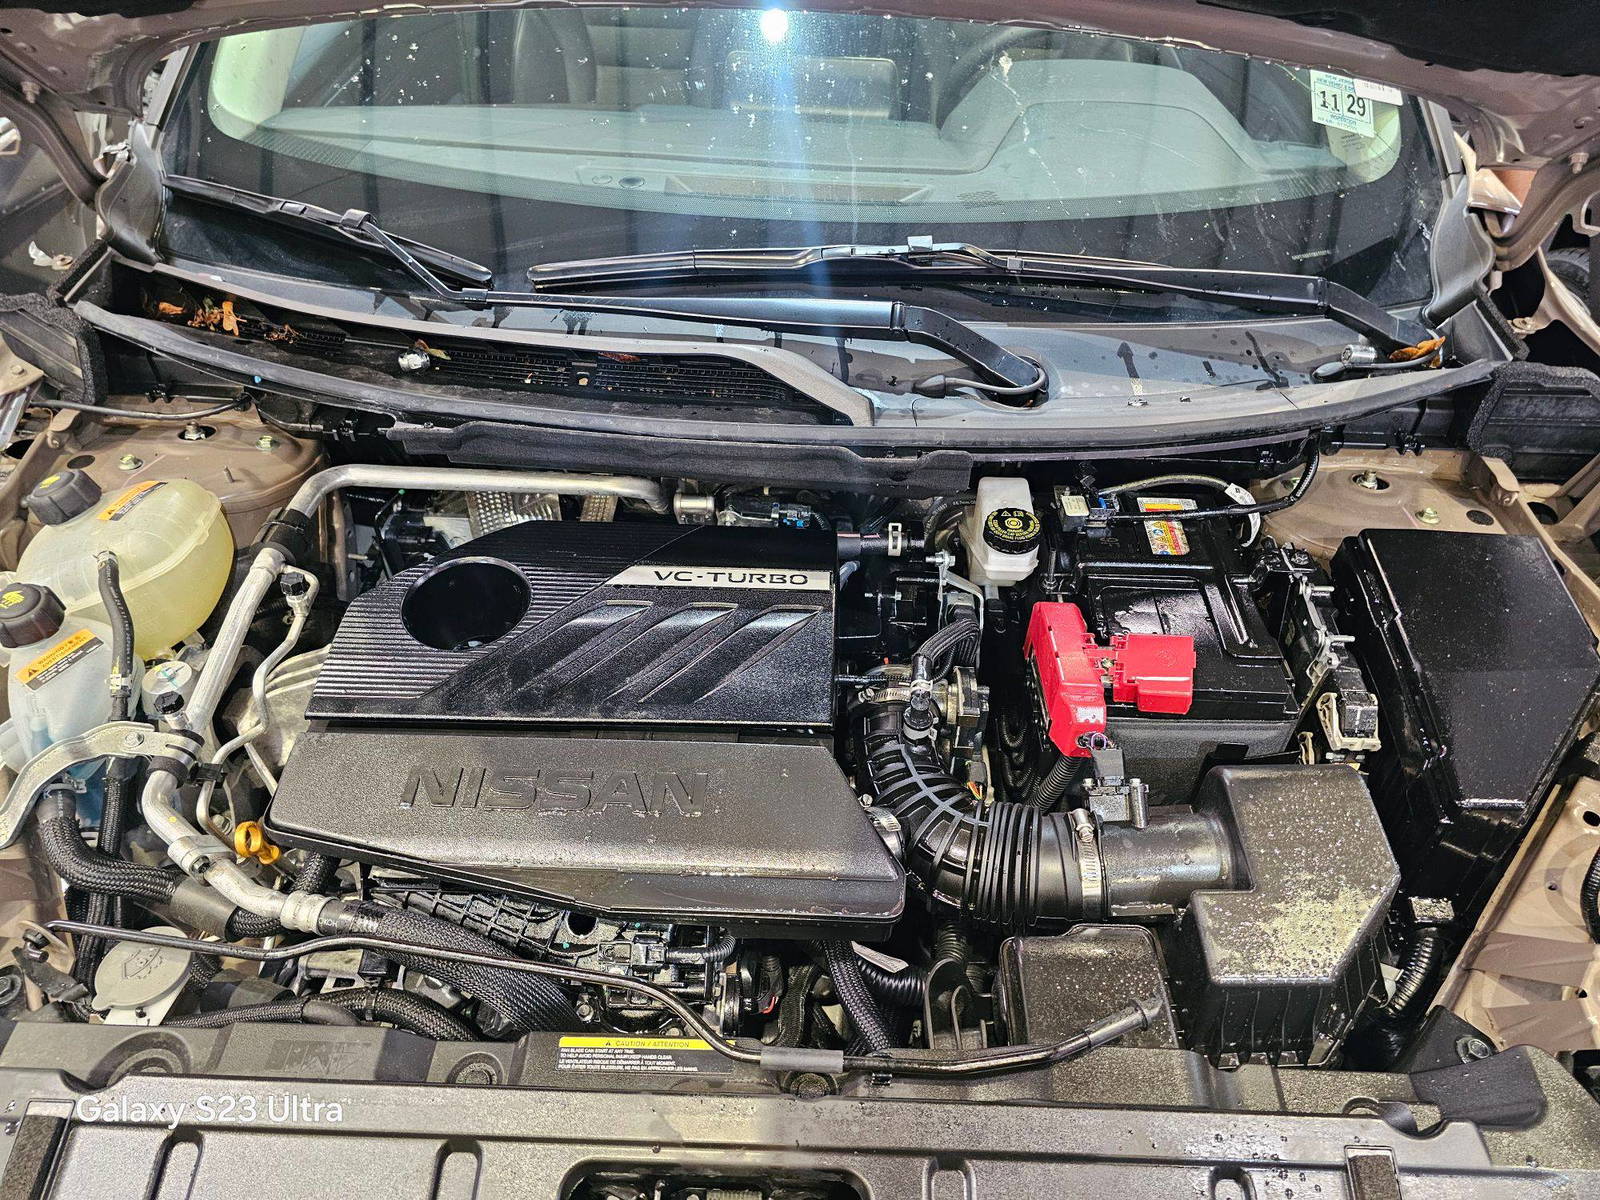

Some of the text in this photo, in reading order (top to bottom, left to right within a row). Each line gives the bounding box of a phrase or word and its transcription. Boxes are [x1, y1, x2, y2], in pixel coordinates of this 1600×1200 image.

[1320, 90, 1366, 117] 11 29
[654, 570, 809, 585] VC-TURBO
[399, 767, 709, 817] NISSAN
